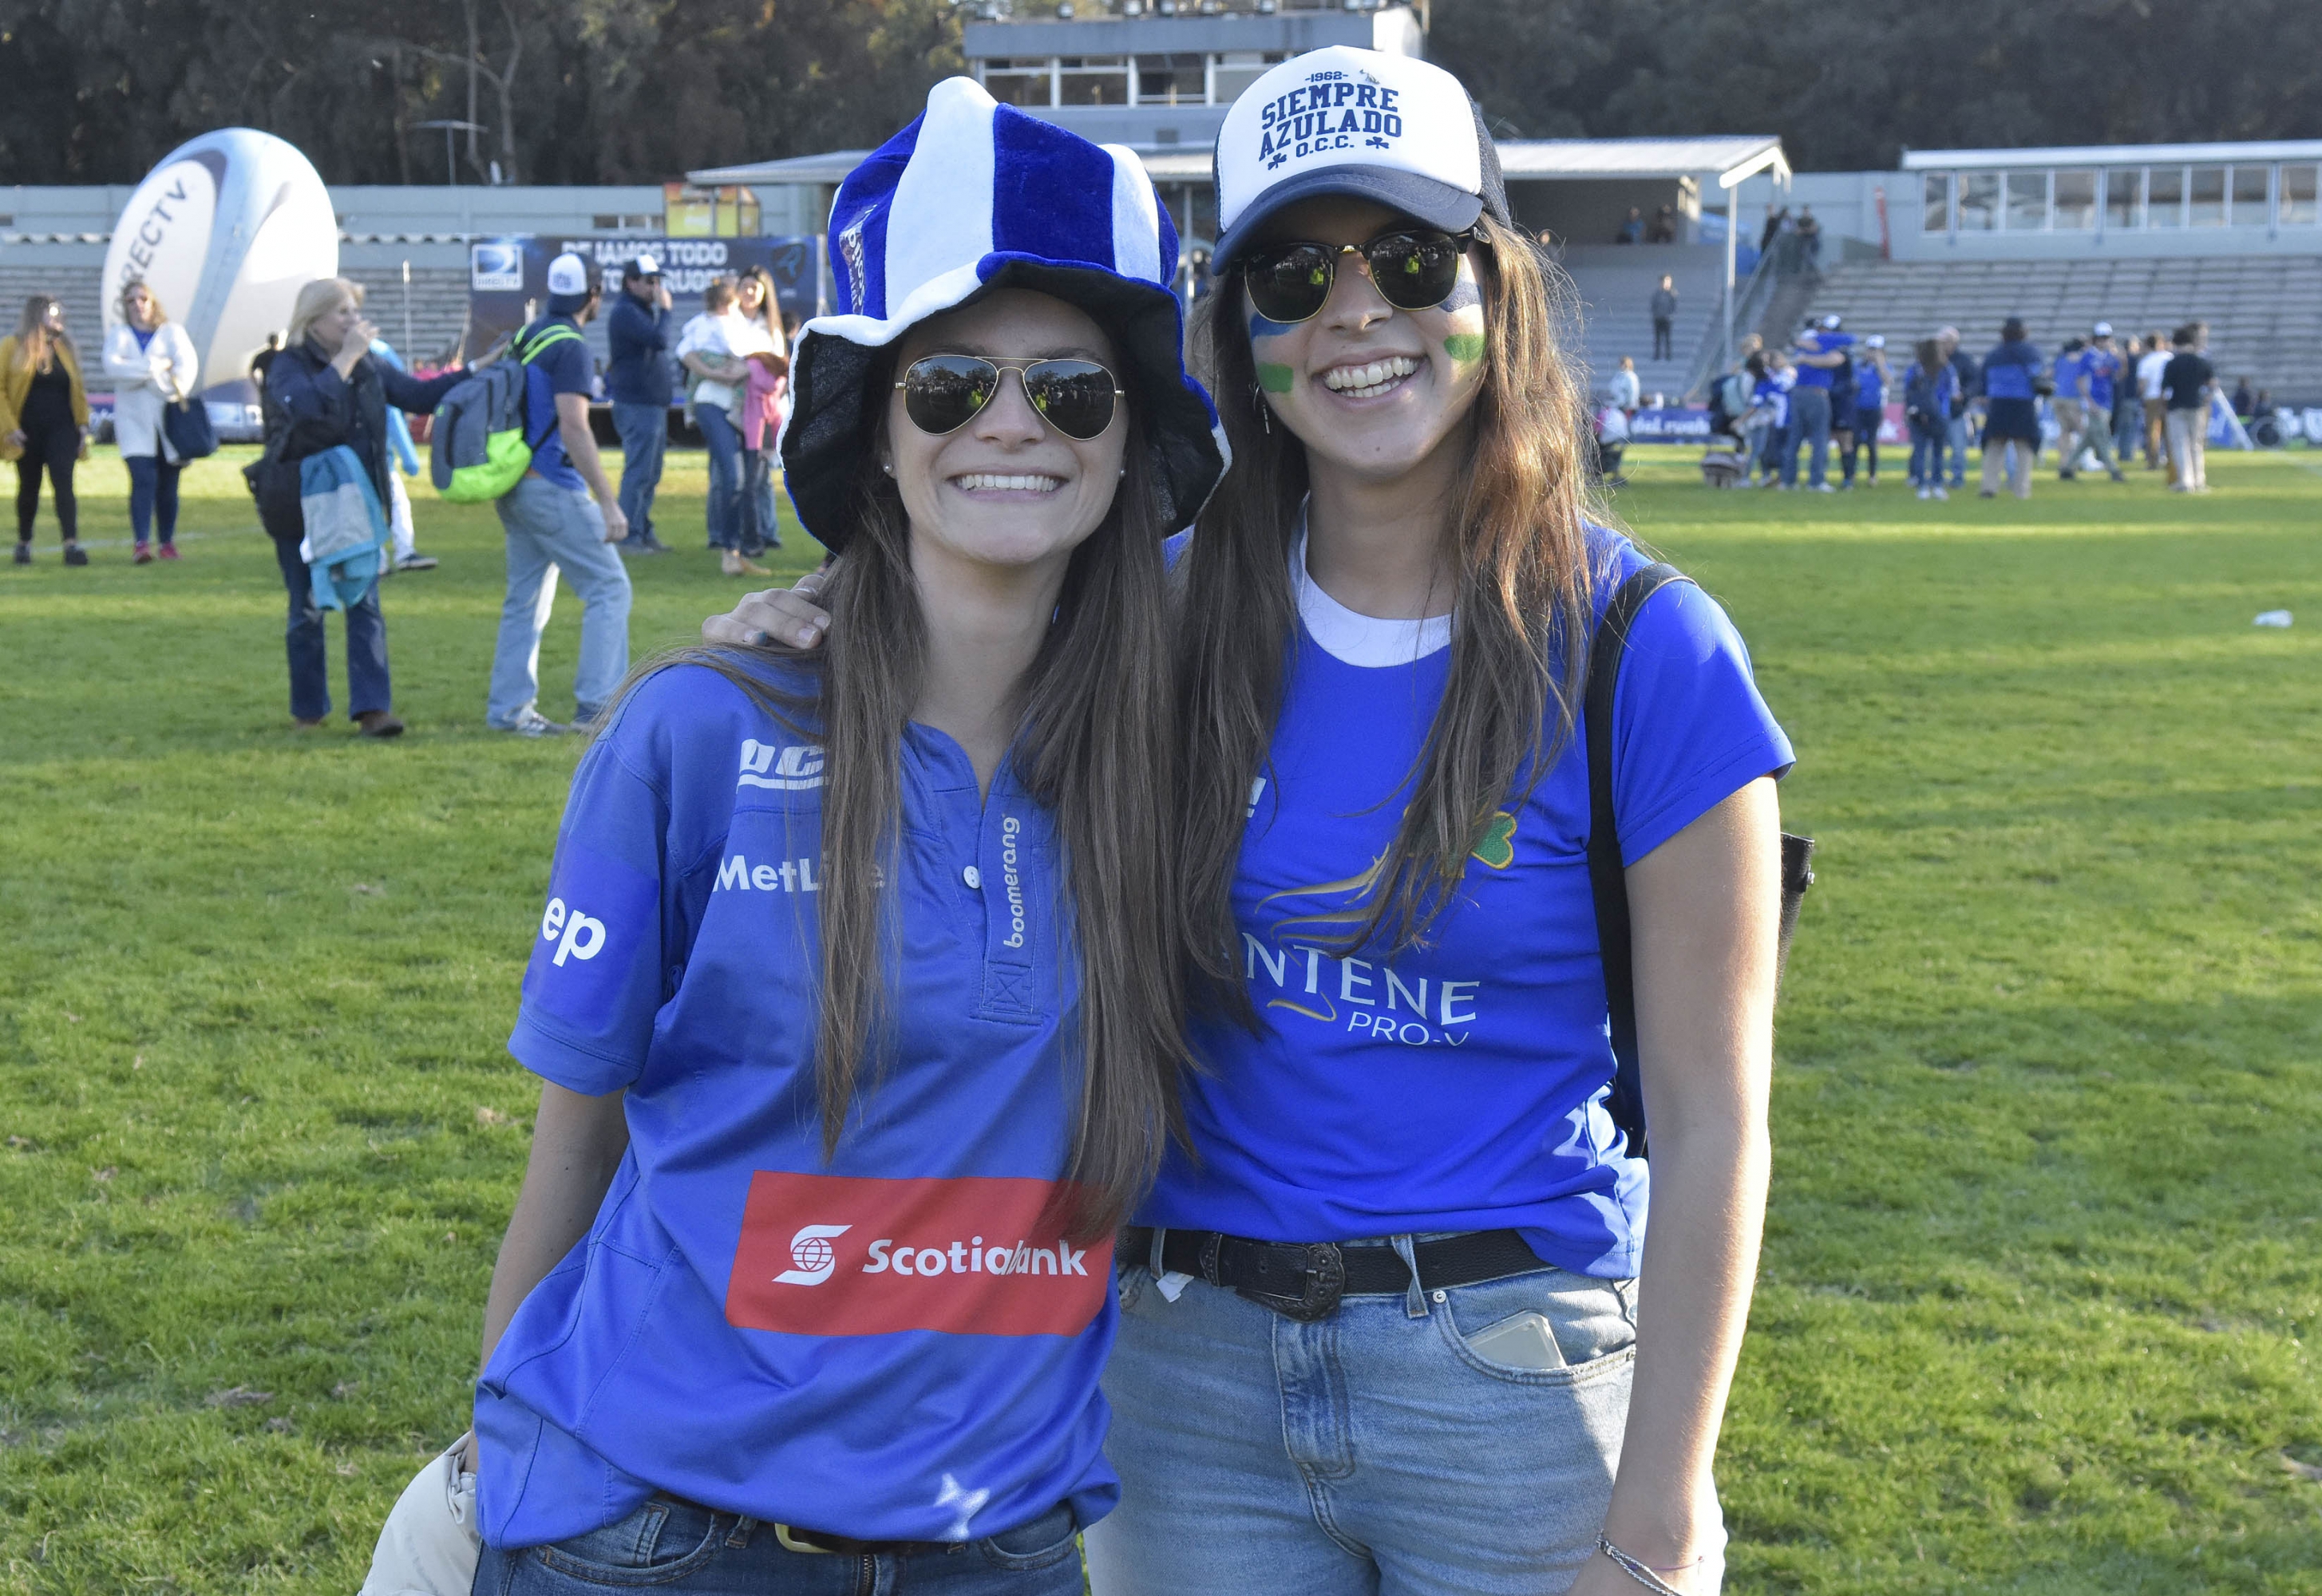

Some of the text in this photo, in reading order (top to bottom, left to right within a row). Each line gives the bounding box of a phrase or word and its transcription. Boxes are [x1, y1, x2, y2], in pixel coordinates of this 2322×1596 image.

[1261, 82, 1399, 130] SIEMPRE
[1258, 109, 1402, 162] AZULADO
[1295, 135, 1355, 158] O.C.C.
[113, 180, 187, 316] DRECTV
[667, 241, 729, 266] TODO
[1002, 816, 1025, 949] boomerang
[1347, 1010, 1470, 1047] PRO-V
